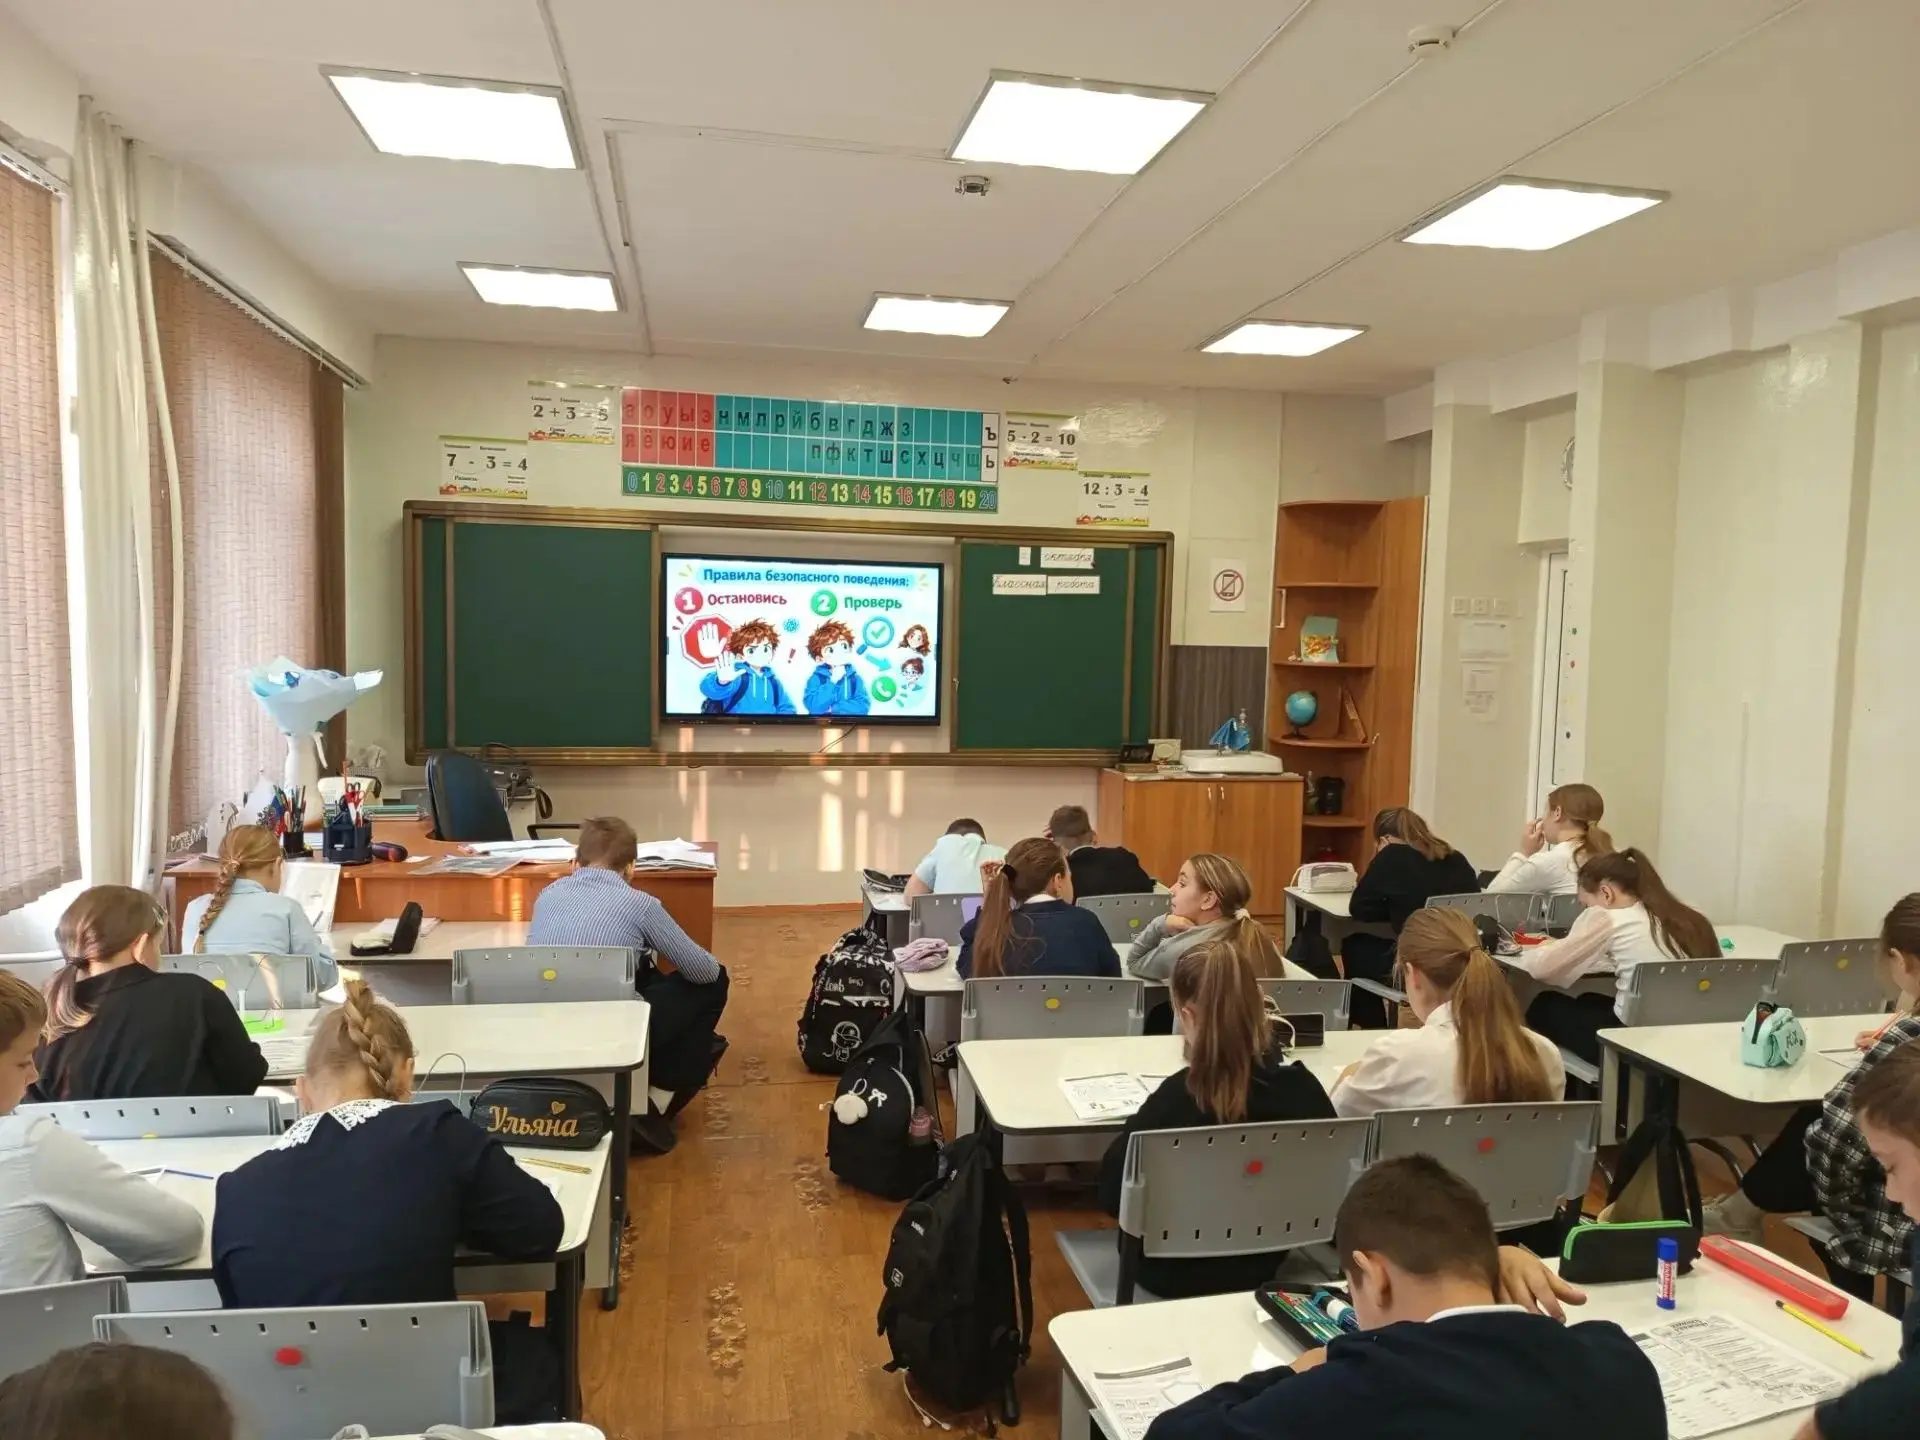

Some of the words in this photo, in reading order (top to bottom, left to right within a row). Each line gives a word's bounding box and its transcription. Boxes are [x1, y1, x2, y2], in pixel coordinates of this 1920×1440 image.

[534, 405, 543, 417] 2
[567, 407, 576, 419] 3
[598, 409, 608, 421] 5
[624, 405, 633, 417] а
[644, 405, 653, 417] о
[664, 406, 674, 425] у
[681, 409, 694, 422] ы
[702, 411, 711, 423] э
[719, 411, 728, 424] н
[738, 412, 749, 426] м
[756, 413, 766, 426] л
[776, 414, 784, 432] р
[793, 410, 801, 429] й
[810, 412, 821, 431] б
[829, 418, 839, 431] в
[848, 419, 855, 432] г
[863, 420, 874, 437] д
[881, 422, 894, 435] ж
[902, 422, 910, 436] з
[1008, 430, 1016, 442] 5
[1031, 432, 1040, 443] 2
[1059, 434, 1075, 445] 10
[625, 434, 635, 448] я
[645, 429, 653, 449] ё
[662, 435, 676, 449] ю
[682, 437, 692, 451] и
[701, 438, 710, 452] е
[812, 445, 821, 458] п
[827, 442, 840, 465] ф
[847, 448, 855, 461] к
[864, 449, 873, 462] т
[880, 451, 893, 464] ш
[900, 450, 910, 464] с
[918, 451, 926, 465] х
[935, 452, 944, 469] ц
[952, 454, 960, 467] ч
[967, 454, 980, 471] щ
[447, 454, 456, 466] 7
[486, 456, 496, 469] 3
[518, 458, 527, 471] 4
[627, 472, 638, 492] 0
[642, 472, 650, 492] 1
[656, 473, 666, 493] 2
[669, 474, 679, 494] 3
[683, 475, 694, 494] 4
[698, 475, 707, 495] 5
[711, 476, 720, 496] 6
[724, 477, 734, 496] 7
[738, 478, 747, 497] 8
[752, 479, 761, 497] 9
[766, 479, 784, 499] 10
[788, 481, 803, 500] 11
[809, 482, 827, 501] 12
[831, 483, 848, 502] 13
[853, 484, 872, 503] 14
[874, 485, 892, 504] 15
[896, 487, 913, 506] 16
[917, 488, 934, 506] 17
[938, 488, 955, 508] 18
[959, 489, 976, 508] 19
[979, 490, 996, 509] 20
[1084, 483, 1099, 494] 12
[1115, 484, 1122, 495] 3
[1141, 485, 1148, 496] 4
[704, 568, 762, 582] Правила
[766, 569, 840, 585] безопасного
[844, 574, 910, 588] поведения:
[682, 591, 696, 611] 1
[708, 593, 788, 606] Остановись
[817, 593, 832, 612] 2
[844, 597, 902, 610] Проверь
[487, 1106, 579, 1137] Ульяна
